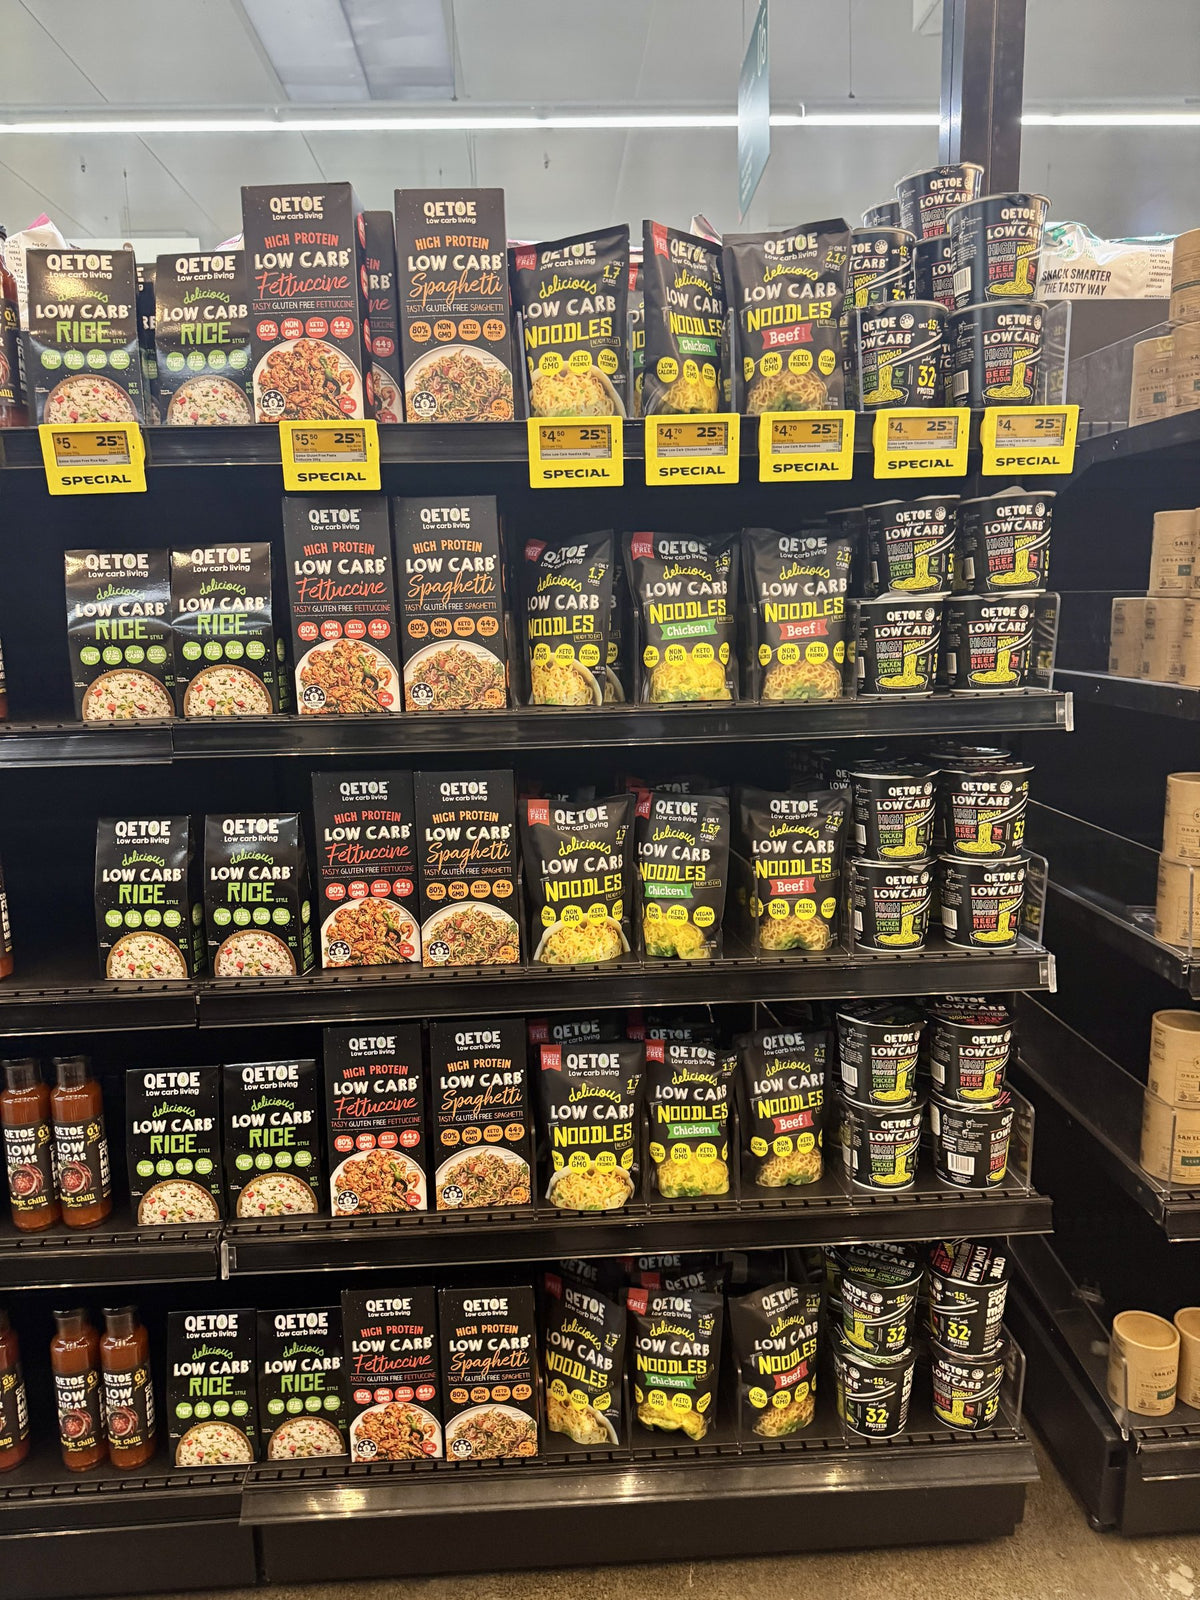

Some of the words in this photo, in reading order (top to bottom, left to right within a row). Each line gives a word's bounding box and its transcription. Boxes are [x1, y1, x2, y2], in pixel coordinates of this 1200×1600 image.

[930, 178, 962, 190] QETOE
[270, 196, 323, 214] QETOE
[424, 201, 477, 218] QETOE
[306, 212, 322, 220] living
[1001, 209, 1035, 220] QETOE
[264, 235, 291, 249] HIGH
[294, 233, 338, 246] PROTEIN
[764, 233, 818, 254] QETOE
[46, 255, 112, 271] QETOE
[254, 252, 295, 268] LOW
[215, 273, 234, 281] living
[989, 266, 1013, 274] BEEF
[989, 272, 1013, 280] FLAVOUR
[1042, 269, 1068, 281] SNACK
[1070, 269, 1111, 281] SMARTER
[257, 271, 350, 298] Fettuccine
[409, 271, 502, 306] Spaghetti
[539, 275, 597, 298] delicious
[675, 270, 712, 296] delicious
[1043, 283, 1057, 294] THE
[1059, 283, 1085, 294] TASTY
[1087, 284, 1106, 295] WAY
[184, 286, 230, 304] delicious
[744, 287, 782, 302] LOW
[788, 282, 836, 298] CARB
[252, 302, 271, 311] TASTY
[271, 302, 297, 310] GLUTEN
[316, 300, 354, 309] FETTUCCINE
[566, 296, 616, 315] CARB
[670, 314, 722, 336] NOODLES
[997, 315, 1031, 326] QETOE
[56, 321, 112, 343] RICE
[259, 324, 276, 334] 80%
[285, 329, 299, 337] GMO
[524, 317, 612, 349] NOODLES
[769, 330, 799, 345] Beef
[984, 333, 1016, 345] LOW
[682, 340, 711, 353] Chicken
[773, 463, 839, 472] SPECIAL
[888, 460, 954, 469] SPECIAL
[996, 457, 1060, 466] SPECIAL
[298, 473, 366, 482] SPECIAL
[543, 468, 610, 478] SPECIAL
[659, 466, 725, 476] SPECIAL
[62, 475, 131, 485] SPECIAL
[309, 509, 361, 523] QETOE
[420, 508, 470, 522] QETOE
[996, 506, 1033, 517] QETOE
[985, 524, 1012, 535] LOW
[304, 543, 328, 555] HIGH
[333, 542, 375, 554] PROTEIN
[658, 540, 706, 555] QETOE
[85, 554, 148, 570] QETOE
[890, 563, 913, 571] CHICKEN
[127, 569, 148, 577] living
[200, 579, 246, 595] delicious
[408, 571, 495, 605] Spaghetti
[650, 598, 725, 624] NOODLES
[95, 619, 148, 640] RICE
[666, 623, 708, 636] Chicken
[787, 623, 815, 636] Beef
[961, 781, 997, 792] QETOE
[531, 812, 547, 820] FREE
[554, 806, 608, 825] QETOE
[222, 819, 279, 835] QETOE
[559, 836, 611, 857] delicious
[752, 840, 787, 854] LOW
[792, 840, 834, 853] CARB
[103, 869, 135, 882] LOW
[756, 858, 831, 879] NOODLES
[972, 1035, 1003, 1044] QETOE
[567, 1054, 620, 1070] QETOE
[144, 1072, 200, 1089] QETOE
[334, 1097, 418, 1118] Fettuccine
[780, 1115, 804, 1130] Beef
[249, 1127, 296, 1148] RICE
[554, 1122, 632, 1147] NOODLES
[57, 1142, 85, 1154] LOW
[58, 1153, 86, 1162] SUGAR
[76, 1195, 95, 1203] Chilli
[990, 1256, 1006, 1279] QETOE
[185, 1314, 238, 1331] QETOE
[361, 1327, 382, 1337] HIGH
[387, 1325, 423, 1334] PROTEIN
[947, 1322, 969, 1340] 32
[636, 1336, 666, 1356] LOW
[670, 1341, 710, 1357] CARB
[450, 1350, 529, 1377] Spaghetti
[758, 1338, 817, 1375] NOODLES
[174, 1363, 205, 1376] LOW
[281, 1373, 326, 1393] RICE
[650, 1376, 687, 1387] Chicken
[58, 1401, 87, 1409] SUGAR
